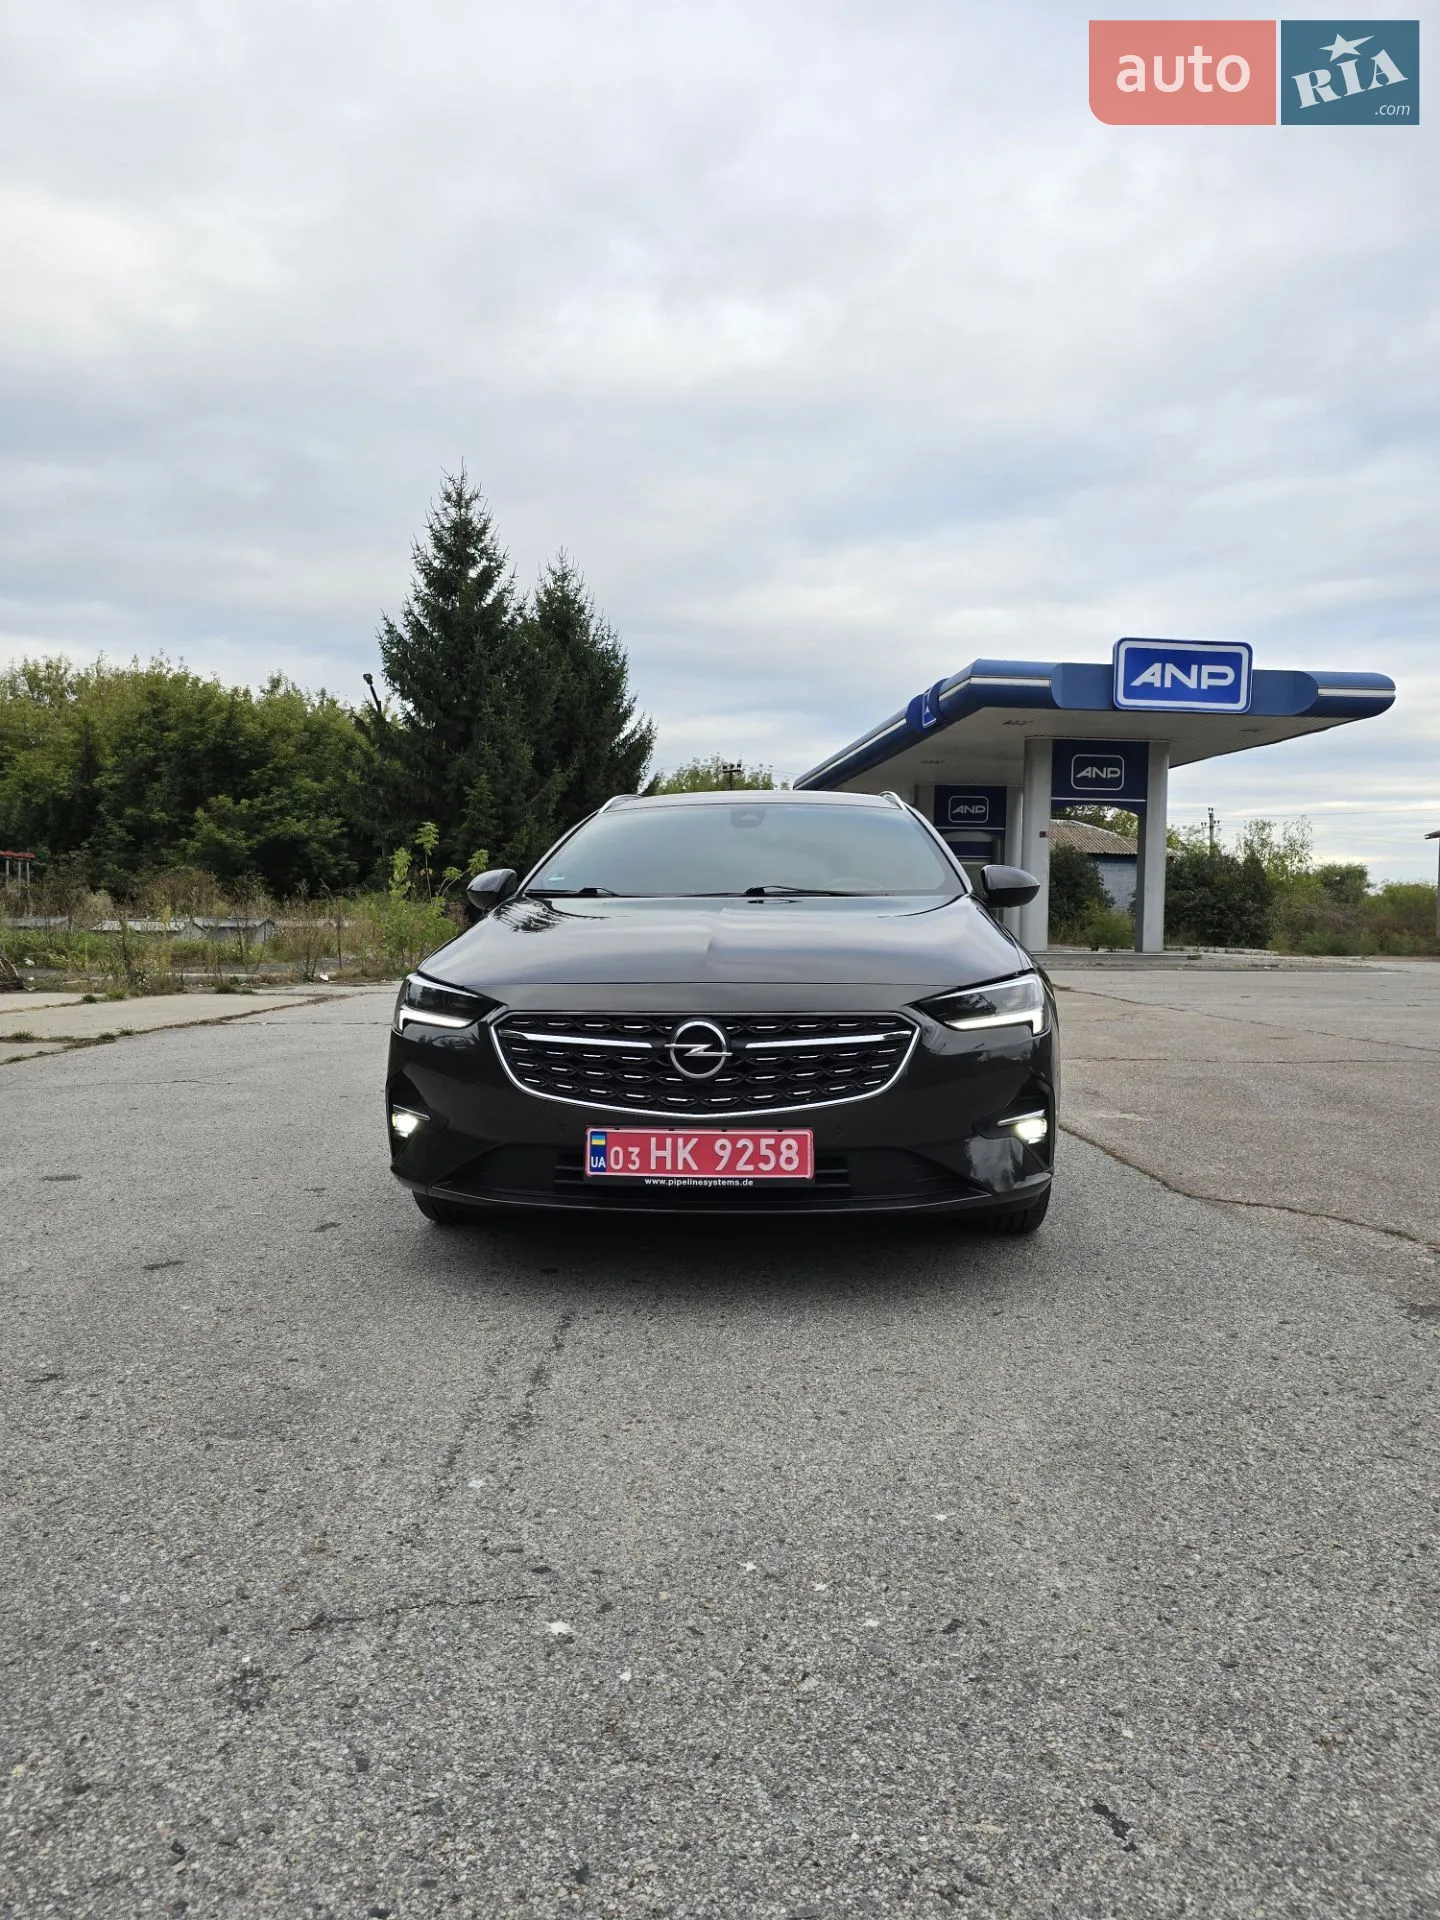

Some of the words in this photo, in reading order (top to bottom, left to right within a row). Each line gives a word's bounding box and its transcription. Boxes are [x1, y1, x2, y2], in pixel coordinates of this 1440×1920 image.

[1130, 662, 1235, 689] ANP
[1075, 766, 1121, 779] ANP
[951, 804, 986, 814] ANP
[591, 1156, 606, 1168] UA
[610, 1145, 640, 1170] 03
[650, 1136, 700, 1171] HK
[714, 1138, 800, 1172] 9258
[644, 1178, 754, 1187] www.pipelinesystems.de
